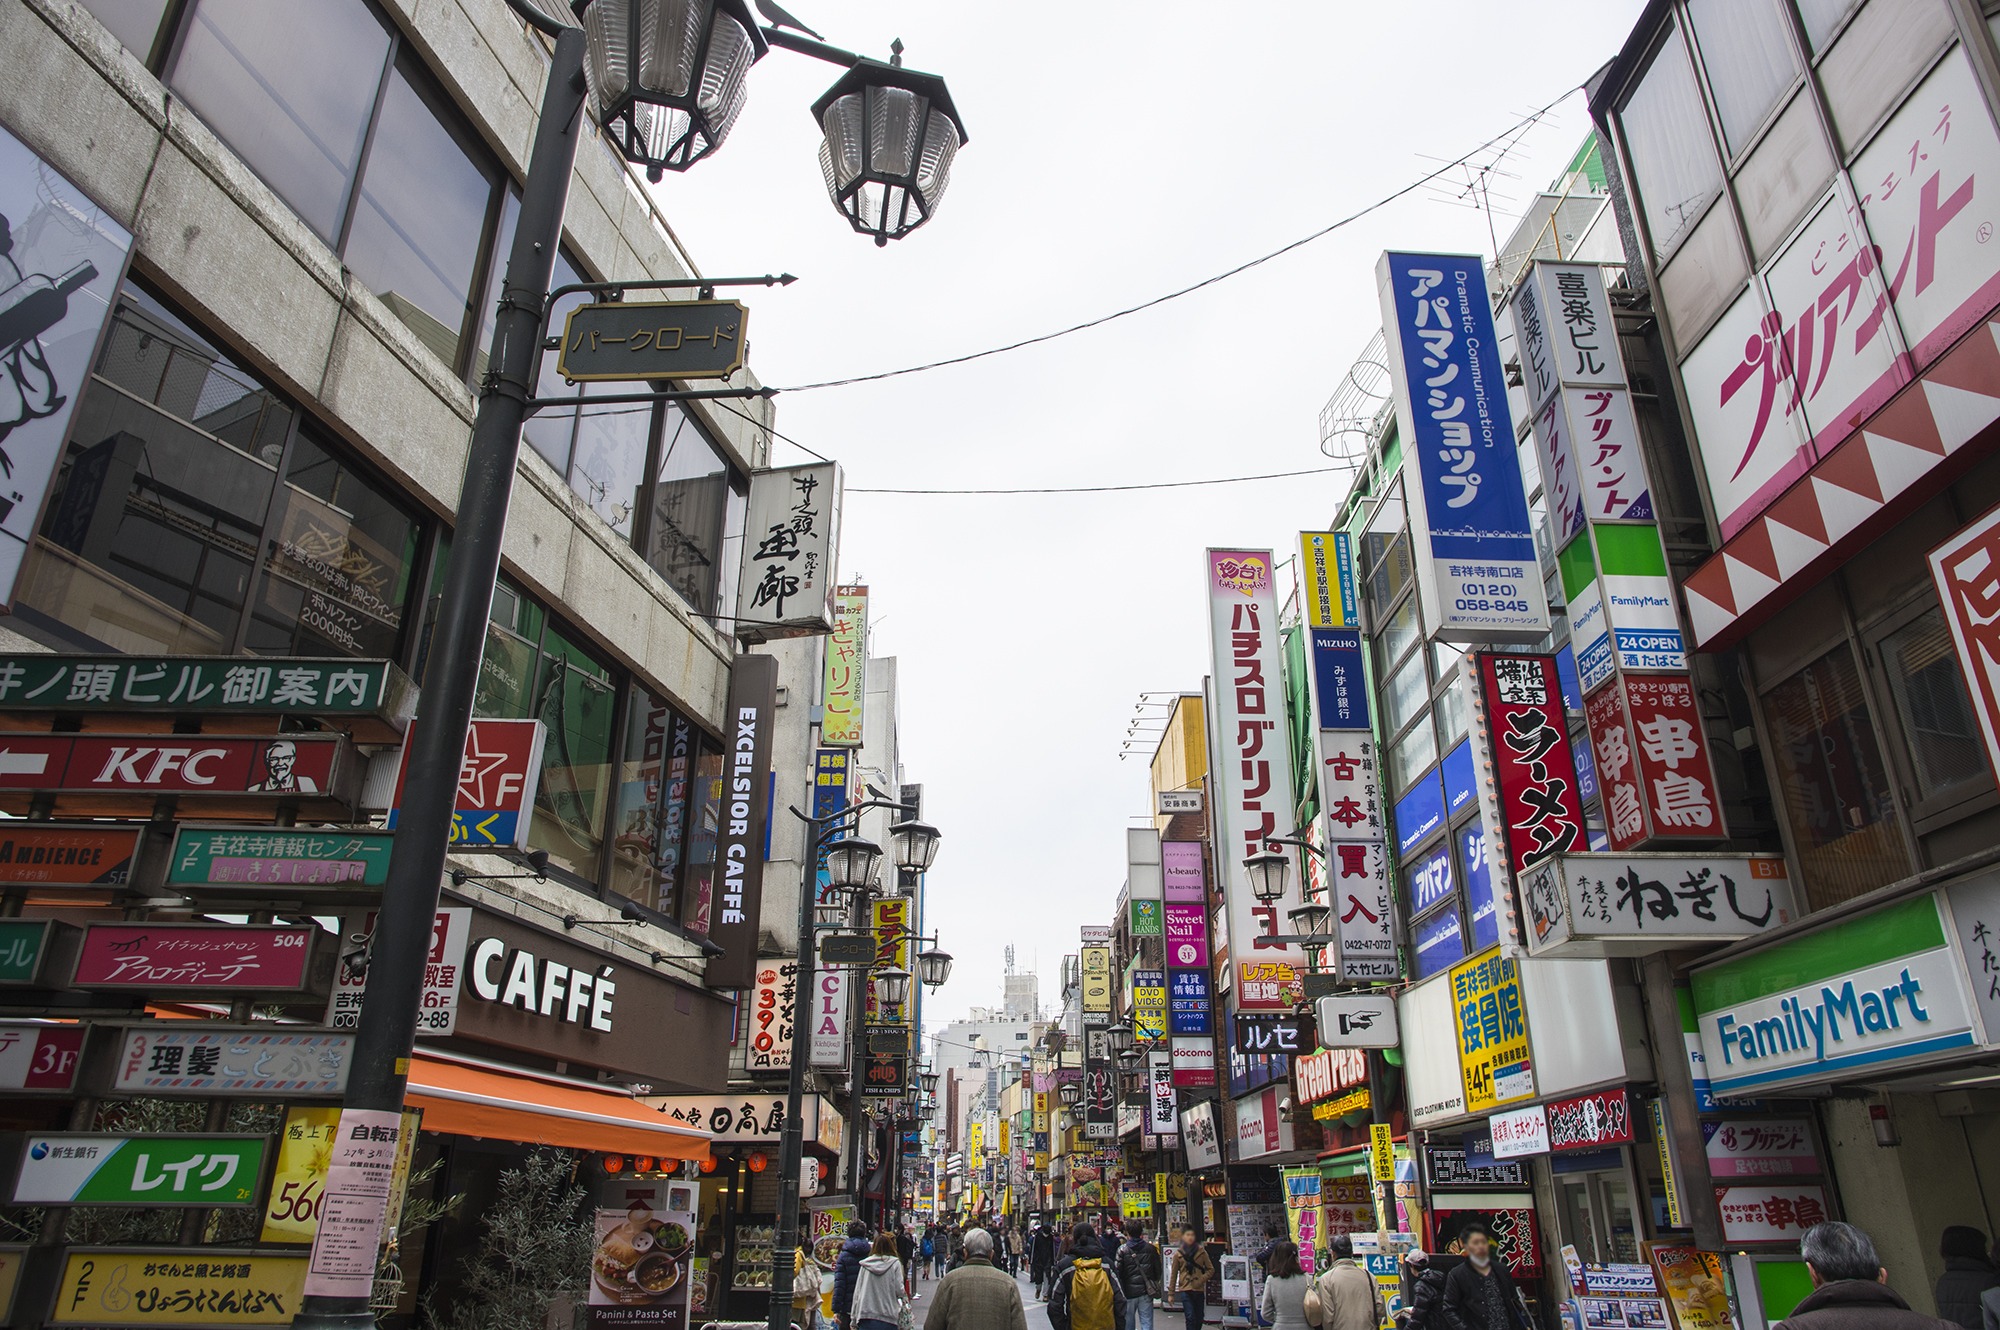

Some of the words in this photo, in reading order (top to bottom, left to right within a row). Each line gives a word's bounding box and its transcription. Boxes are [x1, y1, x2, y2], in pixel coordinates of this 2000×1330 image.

[1556, 272, 1606, 375] 喜楽ビル
[573, 322, 737, 352] パークロード
[1520, 284, 1550, 401] 喜楽ビル
[1454, 271, 1473, 334] Dramatic
[1466, 337, 1494, 449] Communication
[1408, 269, 1482, 509] アパマンショップ
[1583, 392, 1628, 513] ブリアント
[1543, 401, 1573, 539] ブリアント
[791, 473, 818, 538] 井之頭
[1632, 506, 1649, 518] 3F
[1449, 564, 1524, 579] 吉祥寺南口店
[839, 587, 857, 597] 4F
[1314, 548, 1332, 624] 吉祥寺駅前接骨院
[1461, 582, 1517, 598] (0120)
[1455, 599, 1528, 613] 058-845
[1610, 595, 1669, 608] FamilyMart
[1573, 600, 1602, 631] FamilyMart
[301, 607, 363, 650] 2000円均一
[1316, 639, 1357, 648] MIZUHO
[828, 619, 855, 713] きゃりこ
[1624, 654, 1639, 667] 酒
[1642, 655, 1682, 667] たばこ
[1584, 675, 1593, 690] 酒
[1592, 658, 1614, 684] たばこ
[1333, 665, 1350, 719] みずほ銀行
[1628, 683, 1690, 694] やきとり専門
[1631, 694, 1692, 708] さっぽろ
[837, 731, 860, 741] 入口
[93, 747, 228, 785] KFC
[819, 755, 846, 768] 日焼
[729, 706, 757, 837] EXCELSIOR
[1637, 714, 1713, 828] 串鳥
[1503, 707, 1578, 872] ラーメン
[1596, 725, 1642, 842] 串鳥
[1453, 790, 1469, 807] cation
[208, 835, 382, 859] 吉祥寺情報センター
[1402, 829, 1420, 850] Dramatic
[0, 841, 102, 866] AMBIENCE
[1166, 868, 1202, 877] A-beauty
[1758, 863, 1783, 877] B1
[721, 843, 746, 924] CAFFÉ
[1414, 856, 1452, 908] アパマン
[1577, 876, 1595, 918] 牛たん
[1595, 880, 1612, 924] 麦とろ
[1615, 864, 1774, 928] ねぎし
[1140, 917, 1154, 926] HOT
[1166, 914, 1204, 925] Sweet
[1135, 926, 1160, 934] HANDS
[1167, 925, 1193, 936] Nail
[155, 939, 261, 952] アイラッシュサロン
[273, 935, 305, 948] 504
[822, 942, 875, 955] パークロード
[1345, 940, 1391, 950] 0422-47-0727
[1181, 951, 1194, 960] 3F
[104, 955, 261, 982] アフロディーテ
[1346, 963, 1394, 976] 大竹ビル
[471, 936, 616, 1033] CAFFÉ
[1179, 974, 1200, 985] 賃貸
[1140, 989, 1160, 997] DVD
[1173, 985, 1206, 996] 情報館
[1242, 983, 1280, 999] 聖地
[1137, 998, 1164, 1006] VIDEO
[1172, 1001, 1188, 1009] RENT
[1460, 982, 1523, 1055] 接骨院
[1716, 968, 1930, 1066] FamilyMart
[1246, 1024, 1298, 1050] ルセ
[33, 1043, 79, 1074] 3F
[124, 1037, 146, 1081] 3F
[1173, 1048, 1213, 1057] docomo
[868, 1066, 897, 1082] HUB
[1295, 1052, 1332, 1105] Green
[1330, 1049, 1365, 1091] Peas
[1472, 1062, 1491, 1094] 4F
[1155, 1062, 1172, 1123] 一軒め酒場
[709, 1100, 785, 1135] 日高屋
[1414, 1107, 1424, 1117] USED
[1424, 1102, 1444, 1114] CLOTHING
[1740, 1127, 1803, 1151] ブリアント
[51, 1146, 98, 1160] 新生銀行
[1375, 1126, 1391, 1179] 防犯カメラ作動中
[130, 1153, 239, 1192] レイク
[1735, 1159, 1793, 1173] 足やせ物語
[237, 1188, 251, 1199] 2F
[1287, 1176, 1321, 1195] WE
[1715, 1188, 1726, 1196] 2F
[1289, 1196, 1322, 1208] LOVE
[1722, 1204, 1762, 1213] やきとり専門
[1725, 1213, 1764, 1223] さっぽろ
[1762, 1195, 1825, 1230] 串鳥
[1372, 1256, 1394, 1270] 4F
[72, 1260, 95, 1312] 2F
[1586, 1275, 1654, 1287] アパマンショップ
[596, 1310, 625, 1320] Panini
[635, 1309, 660, 1319] Pasta
[662, 1309, 677, 1319] Set
